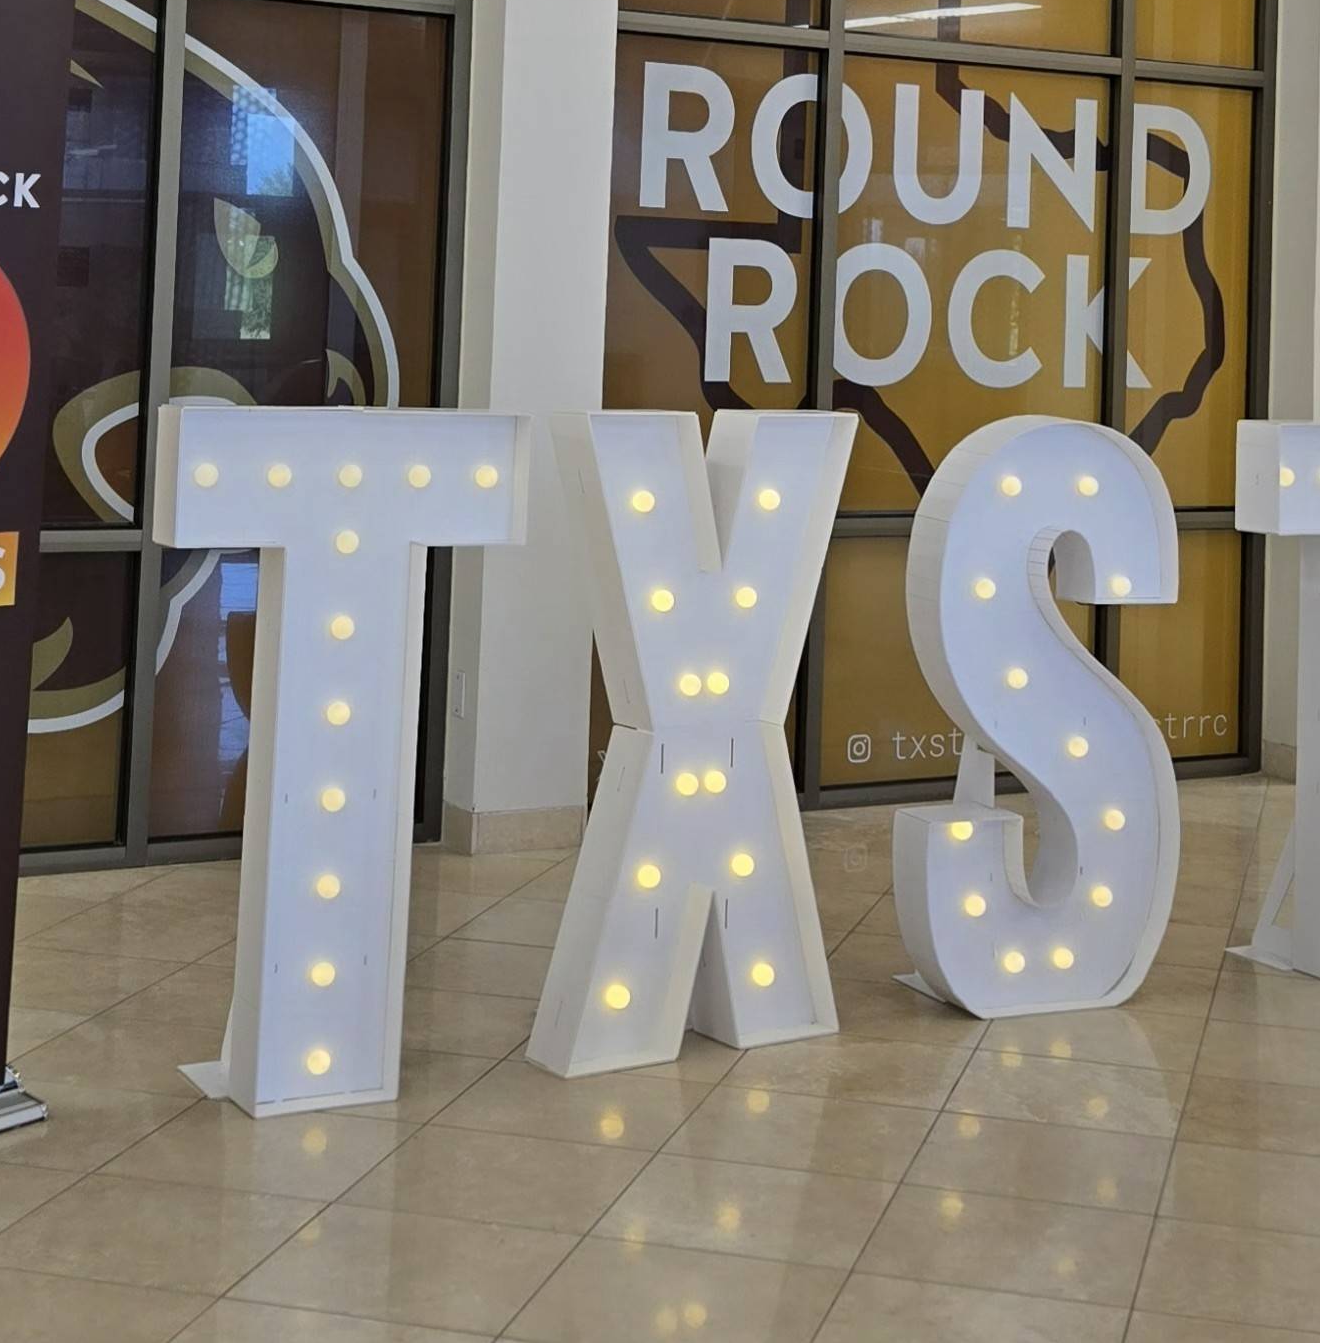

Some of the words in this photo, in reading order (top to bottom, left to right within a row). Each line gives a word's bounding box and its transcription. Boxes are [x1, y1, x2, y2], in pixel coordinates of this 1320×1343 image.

[638, 60, 1212, 237] ROUND
[703, 236, 1155, 390] ROCK
[891, 727, 962, 760] txst
